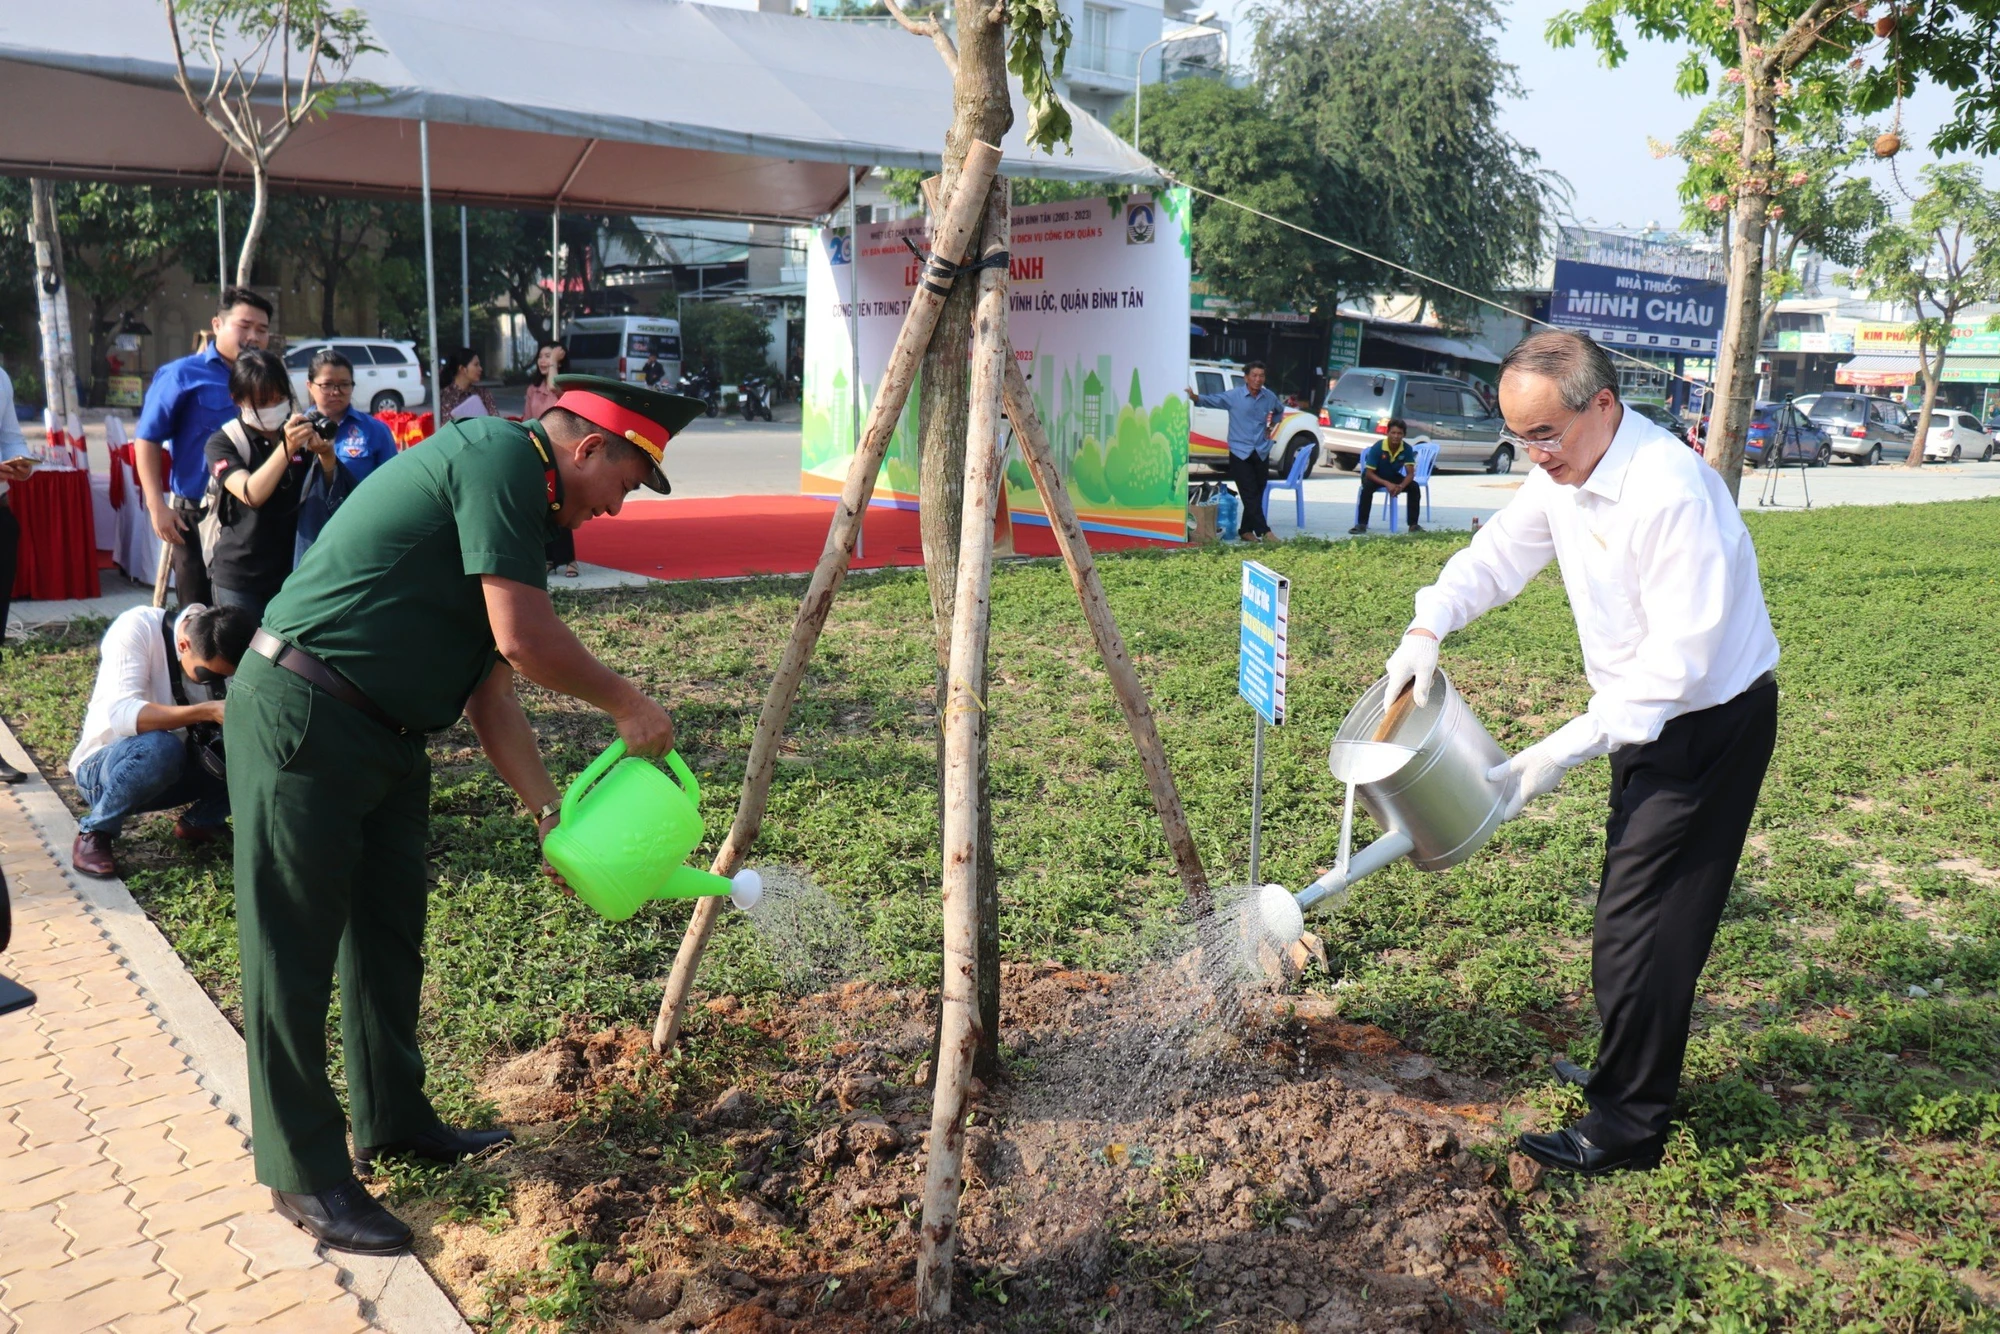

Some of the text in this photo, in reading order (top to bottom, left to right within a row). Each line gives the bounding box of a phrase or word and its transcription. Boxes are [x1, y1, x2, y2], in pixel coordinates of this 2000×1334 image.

[1025, 213, 1039, 225] BÌNH
[1040, 211, 1051, 223] TÂN
[1052, 211, 1069, 223] (2003
[1074, 209, 1092, 221] 2023)
[1017, 233, 1032, 244] DỊCH
[1033, 232, 1043, 244] VỤ
[1044, 229, 1062, 242] CÔNG
[1063, 228, 1075, 240] ÍCH
[1076, 227, 1096, 240] QUẬN
[1097, 227, 1103, 238] 5
[905, 257, 920, 287] LỄ
[1009, 254, 1044, 281] ÀNH
[1615, 273, 1682, 296] NHÀ THUỐC
[832, 299, 852, 317] CÔNG
[873, 301, 900, 317] TRUNG
[1010, 286, 1144, 315] VĨNH LỘC, QUẬN BÌNH TÂN
[1567, 288, 1640, 320] MINH
[1645, 298, 1714, 328] CHÂU
[1863, 331, 1883, 341] KIM
[1885, 329, 1911, 342] PHÁ
[1015, 350, 1034, 362] 2023
[1340, 348, 1356, 358] LONG
